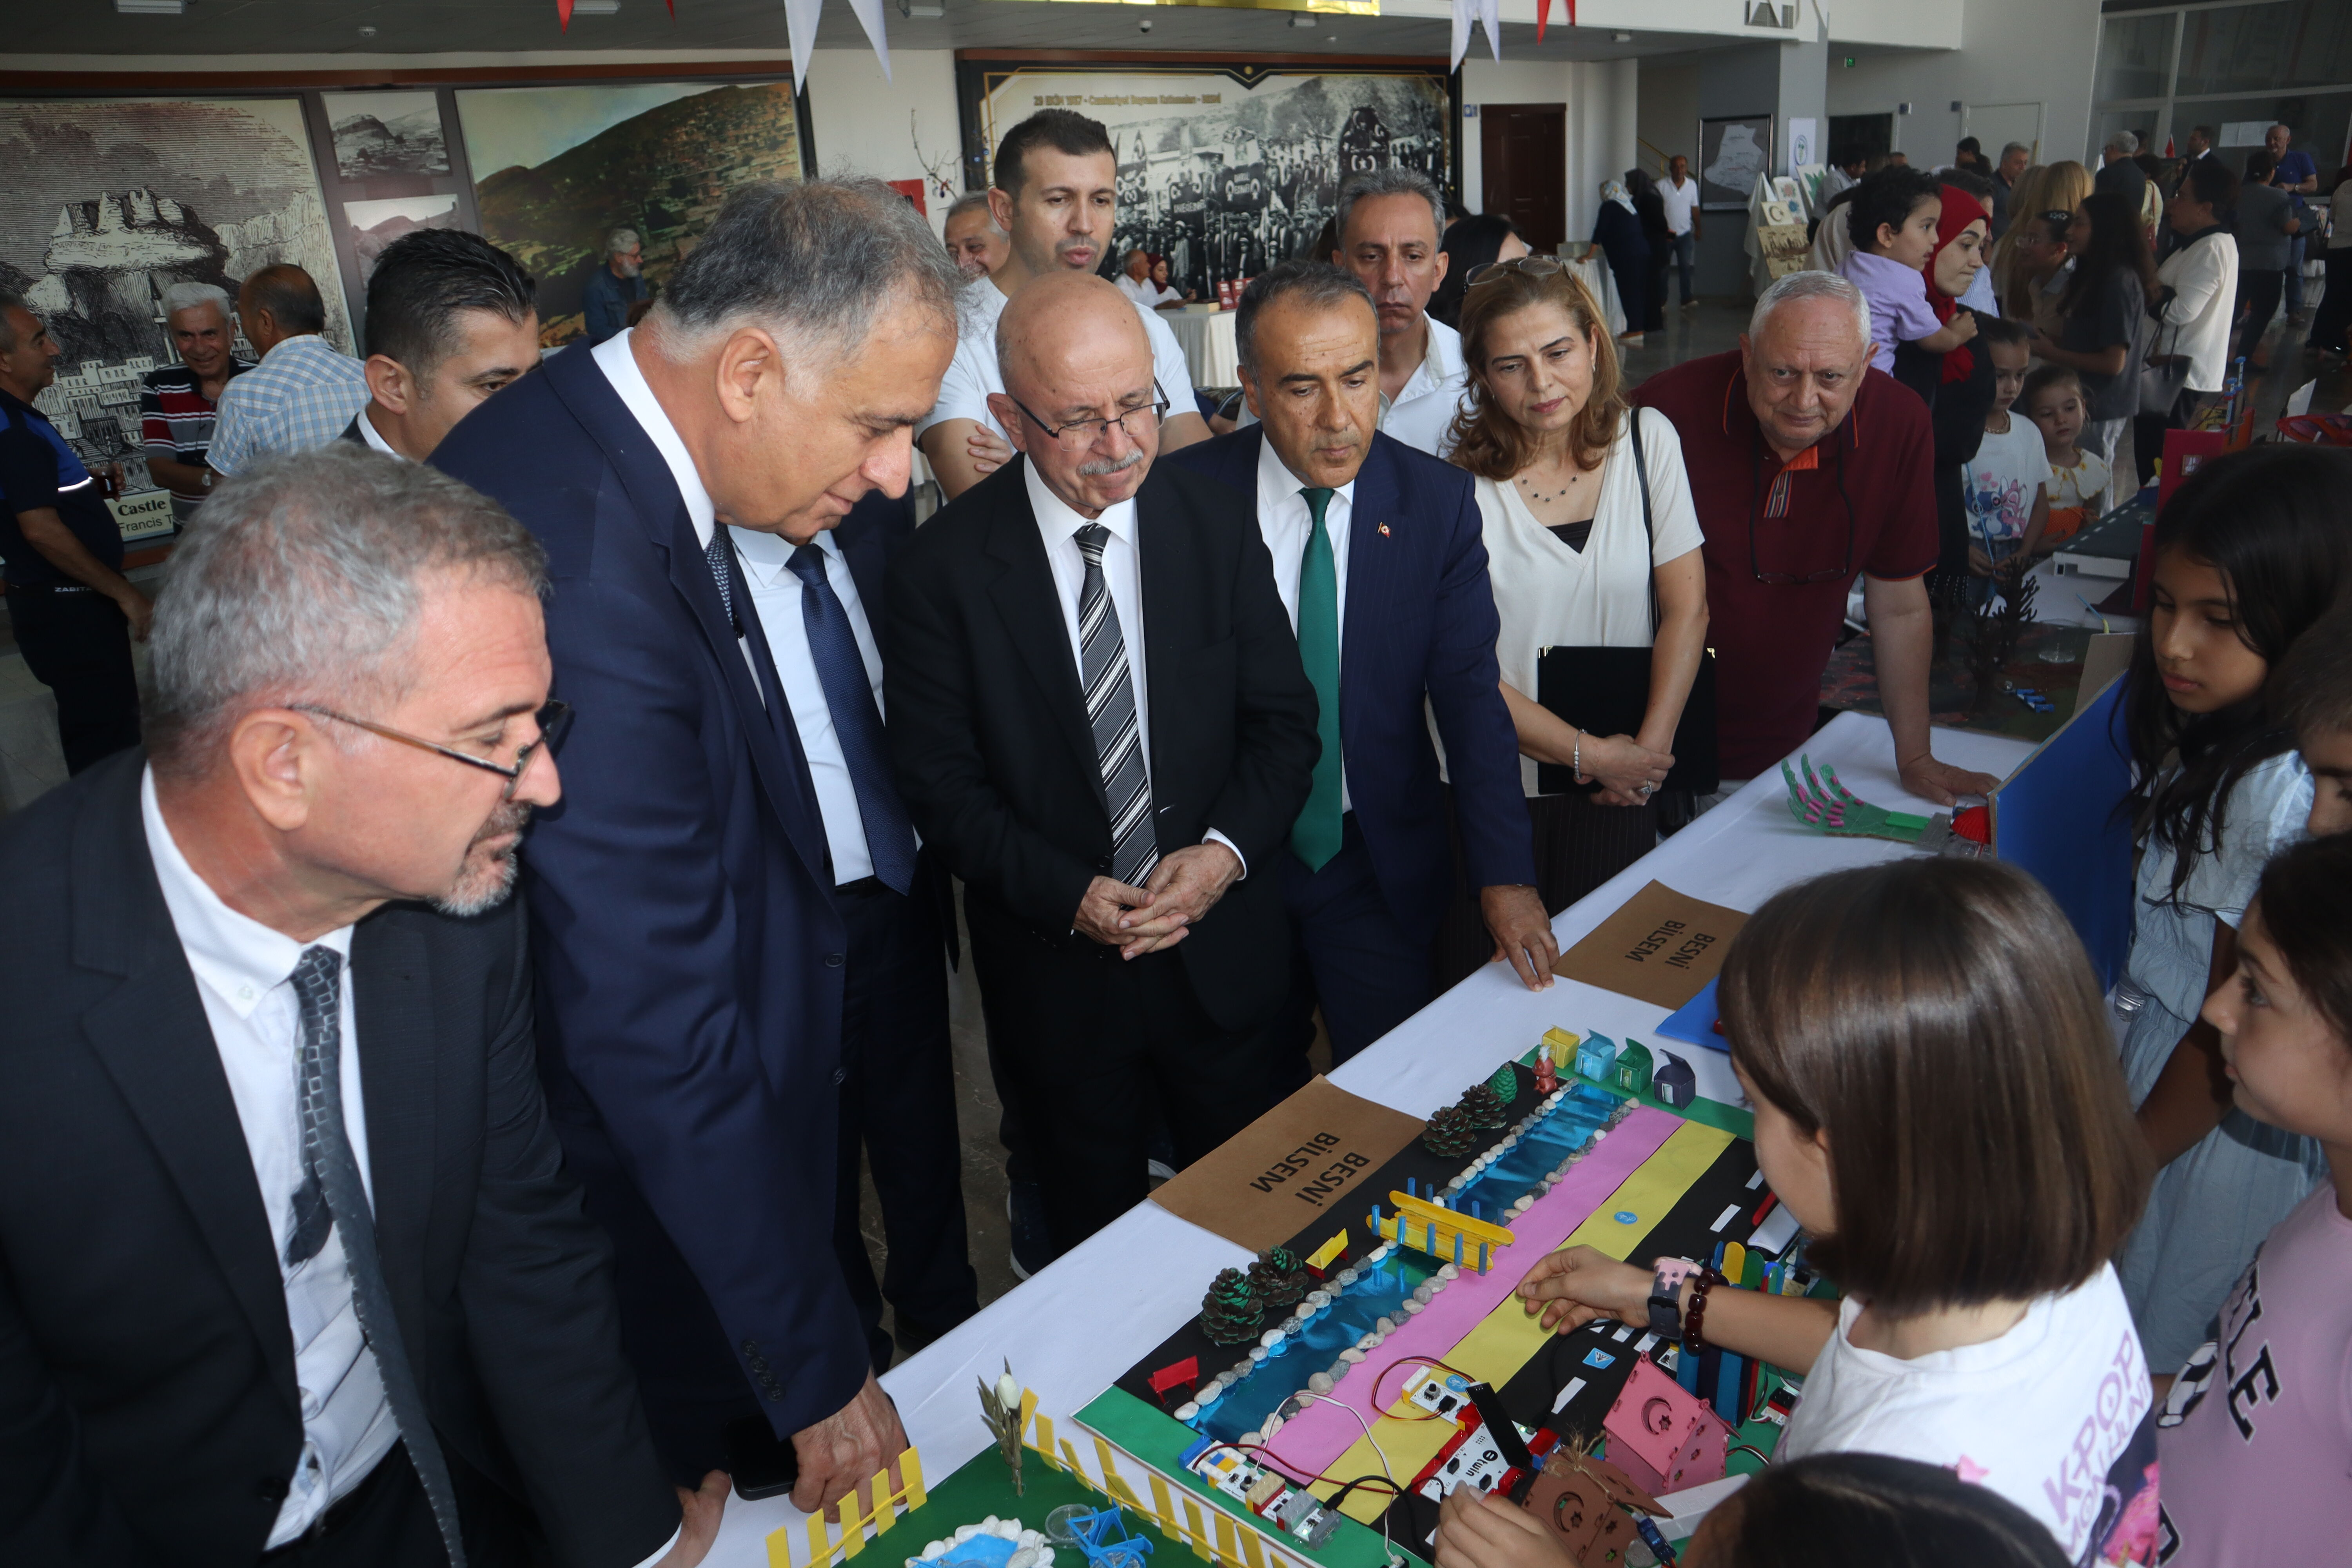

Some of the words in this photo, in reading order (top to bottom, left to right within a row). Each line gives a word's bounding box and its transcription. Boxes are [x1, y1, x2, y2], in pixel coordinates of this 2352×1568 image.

[118, 500, 166, 516] Castle
[118, 517, 163, 532] Francis
[1625, 920, 1686, 962] BİLSEM
[1665, 933, 1717, 969] BESNİ
[1249, 1132, 1341, 1192] BİLSEM
[1295, 1152, 1370, 1207] BESNİ
[2042, 1330, 2134, 1526] KPOP
[1466, 1459, 1488, 1476] twin
